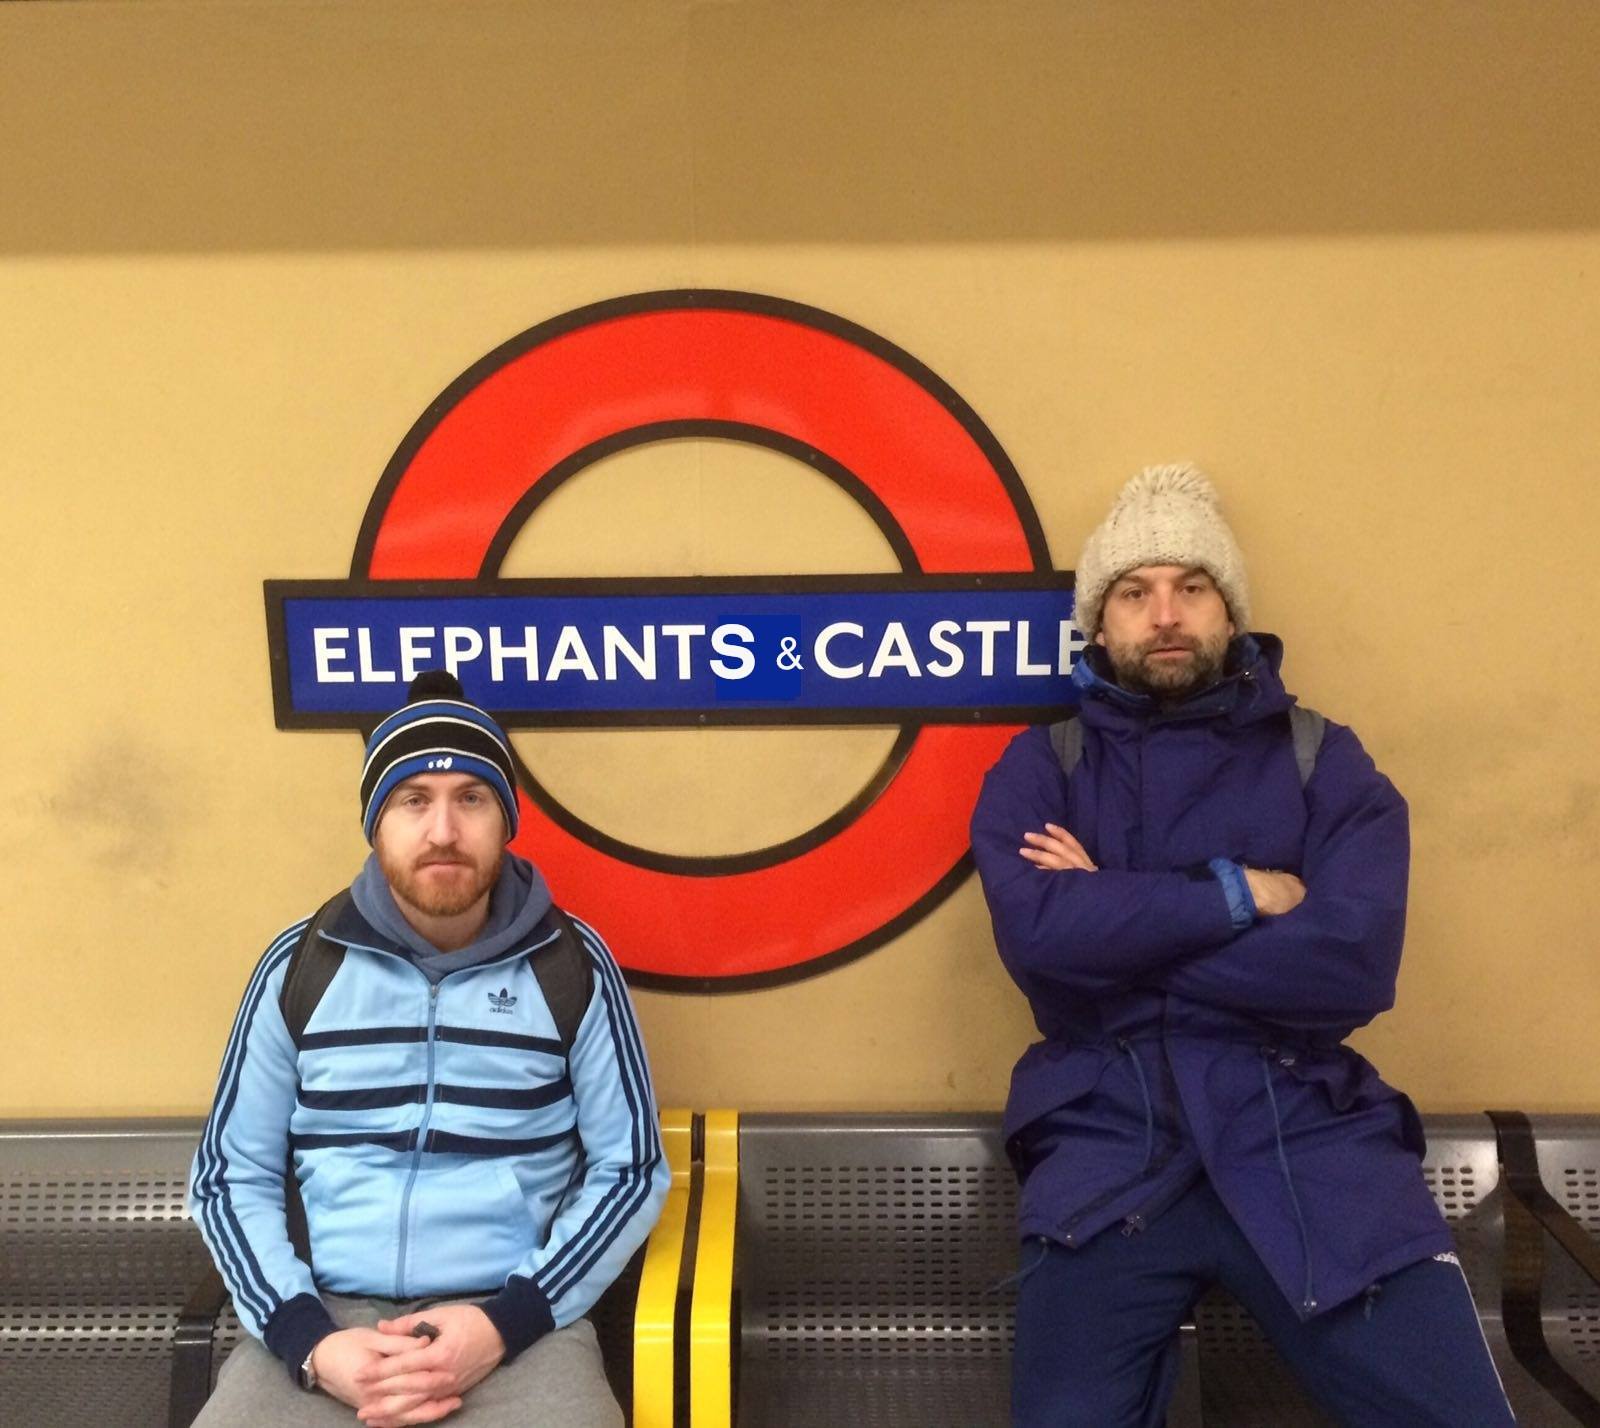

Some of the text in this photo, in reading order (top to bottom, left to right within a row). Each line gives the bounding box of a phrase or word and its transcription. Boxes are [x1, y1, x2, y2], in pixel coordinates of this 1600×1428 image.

[313, 620, 1090, 683] ELEPHANTS & CASTLE
